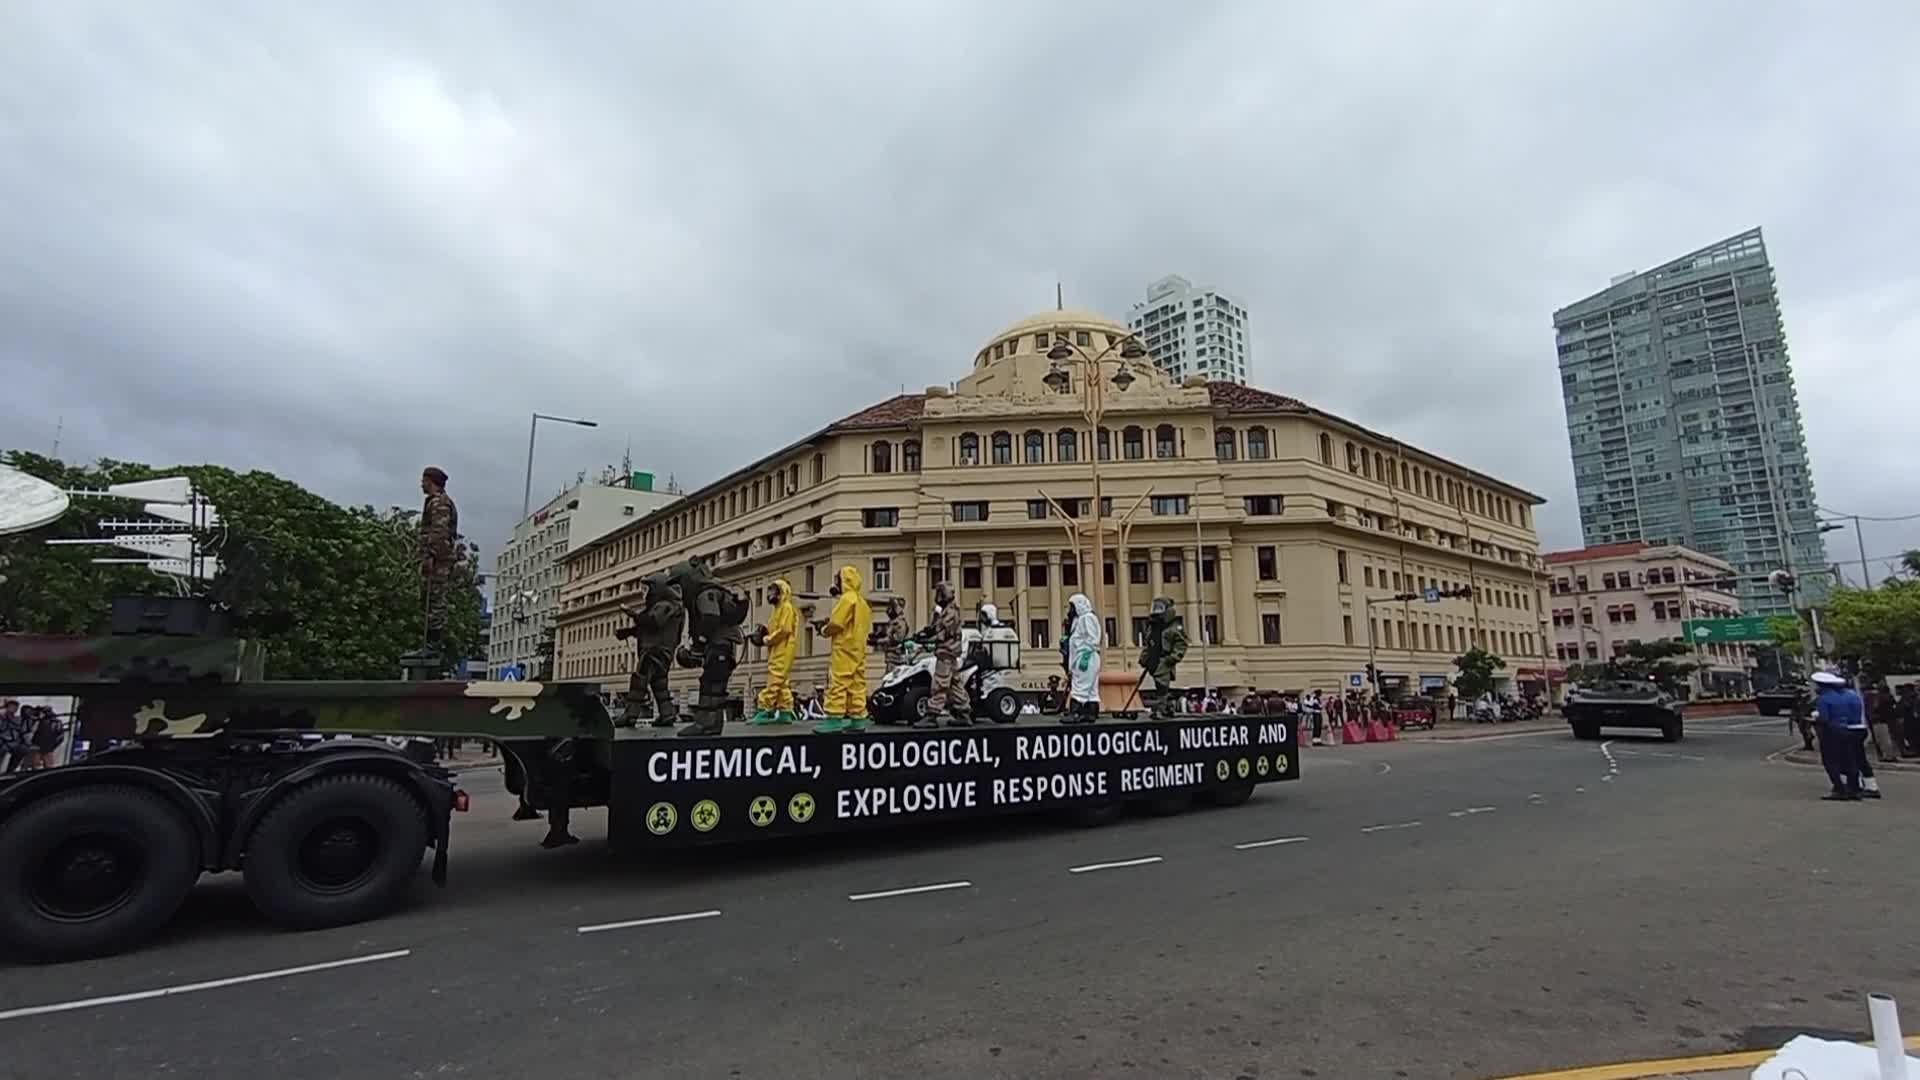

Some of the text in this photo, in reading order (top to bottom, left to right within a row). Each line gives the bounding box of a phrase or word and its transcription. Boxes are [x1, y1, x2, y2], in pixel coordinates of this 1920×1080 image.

[648, 723, 1287, 782] CHEMICAL, BIOLOGICAL, RADIOLOGICAL, NUCLEAR AND
[837, 762, 1205, 818] EXPLOSIVE RESPONSE REGIMENT
